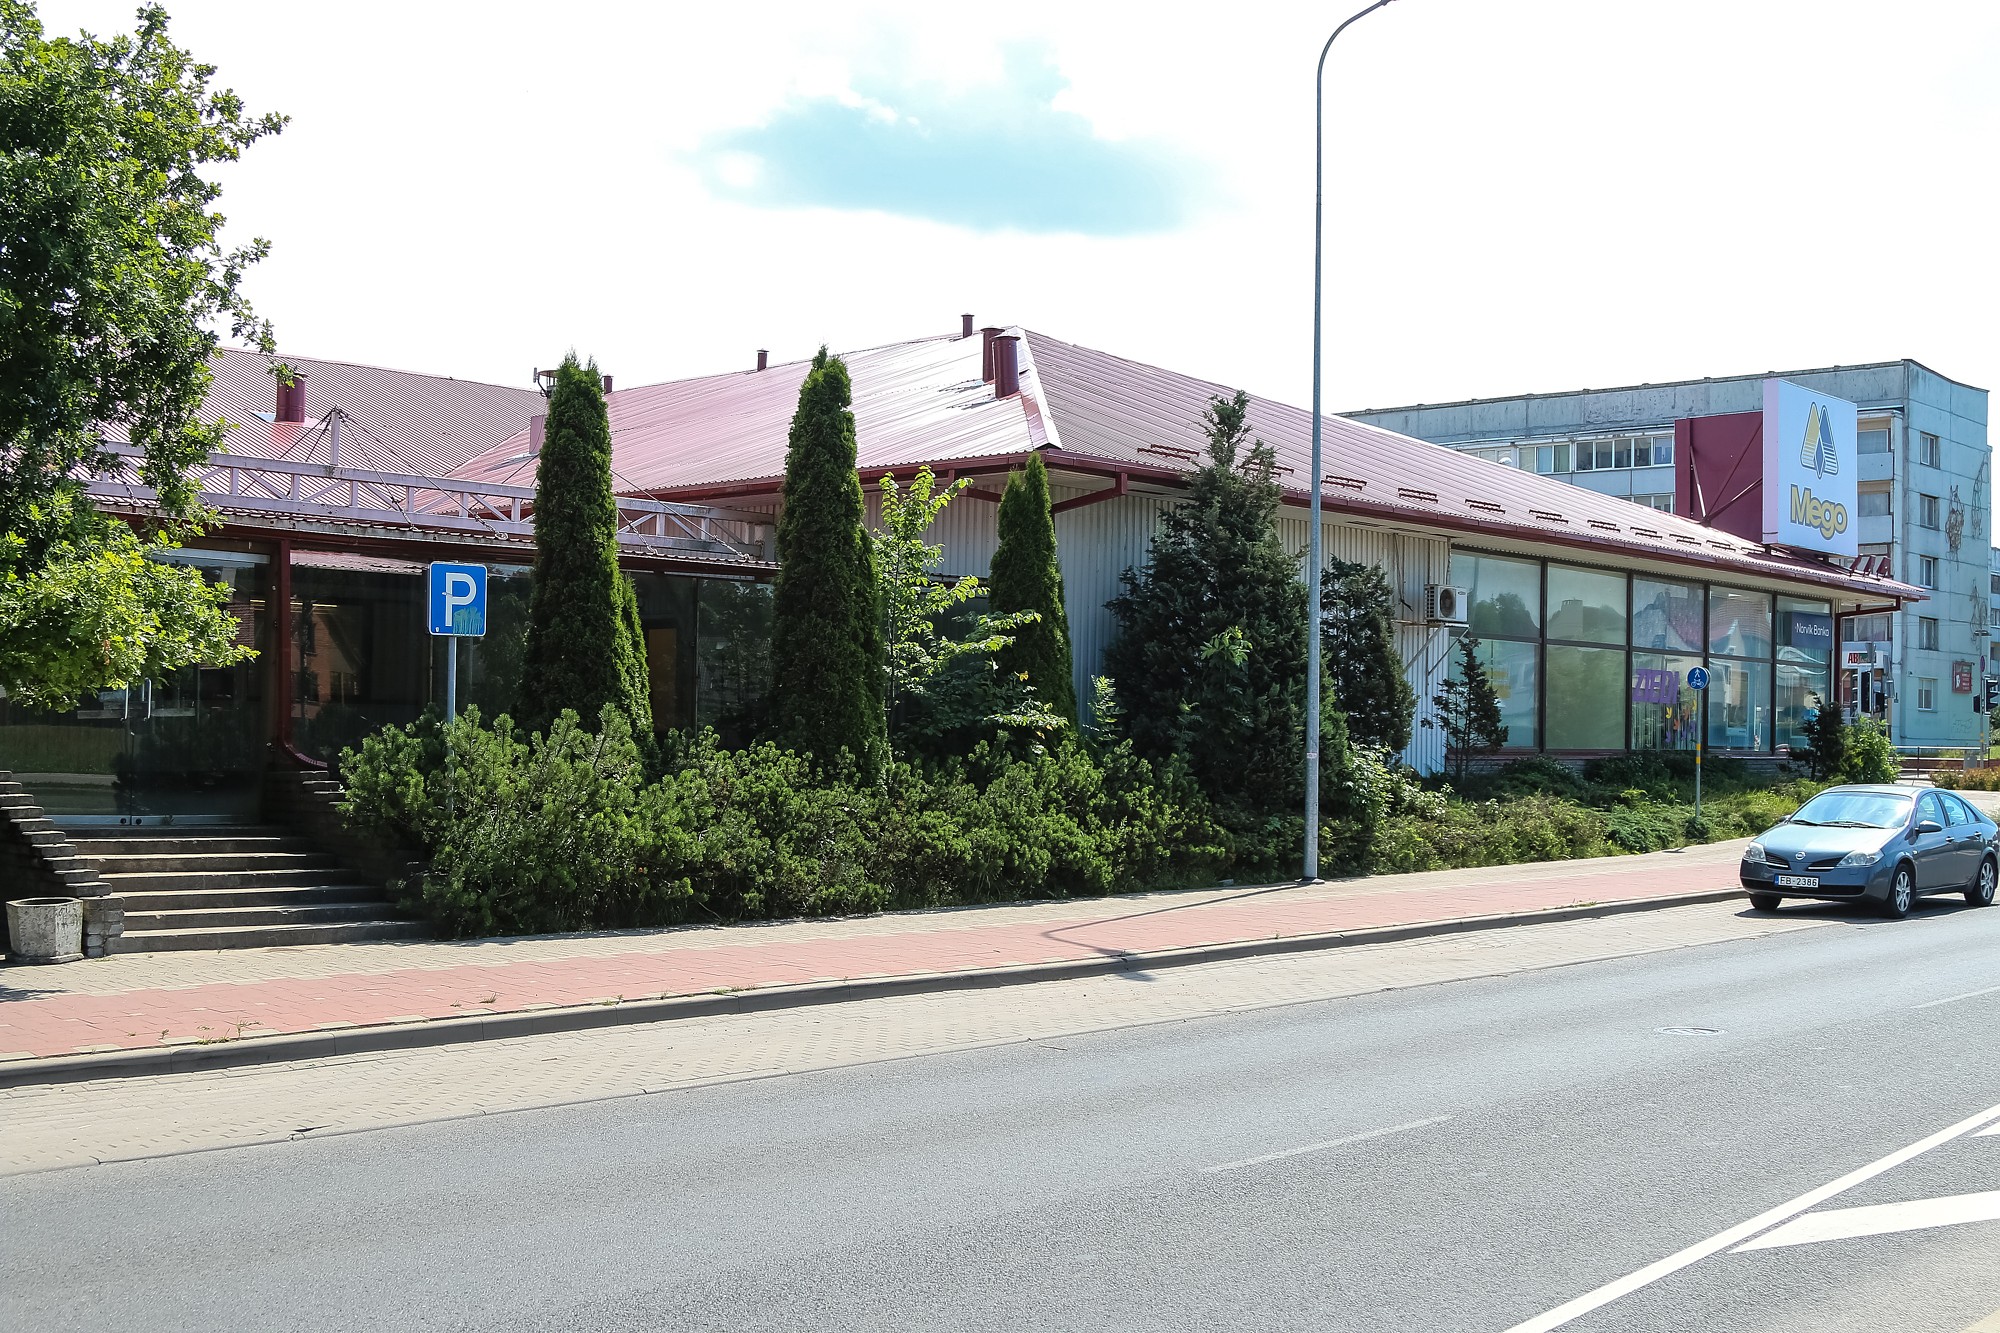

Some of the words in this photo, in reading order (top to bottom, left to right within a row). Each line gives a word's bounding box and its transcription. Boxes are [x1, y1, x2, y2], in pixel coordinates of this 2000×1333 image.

[1790, 483, 1848, 540] Mego
[445, 572, 477, 627] P
[1796, 622, 1813, 635] Norvik
[1813, 624, 1830, 637] Banka
[1632, 669, 1679, 704] ZIEDI
